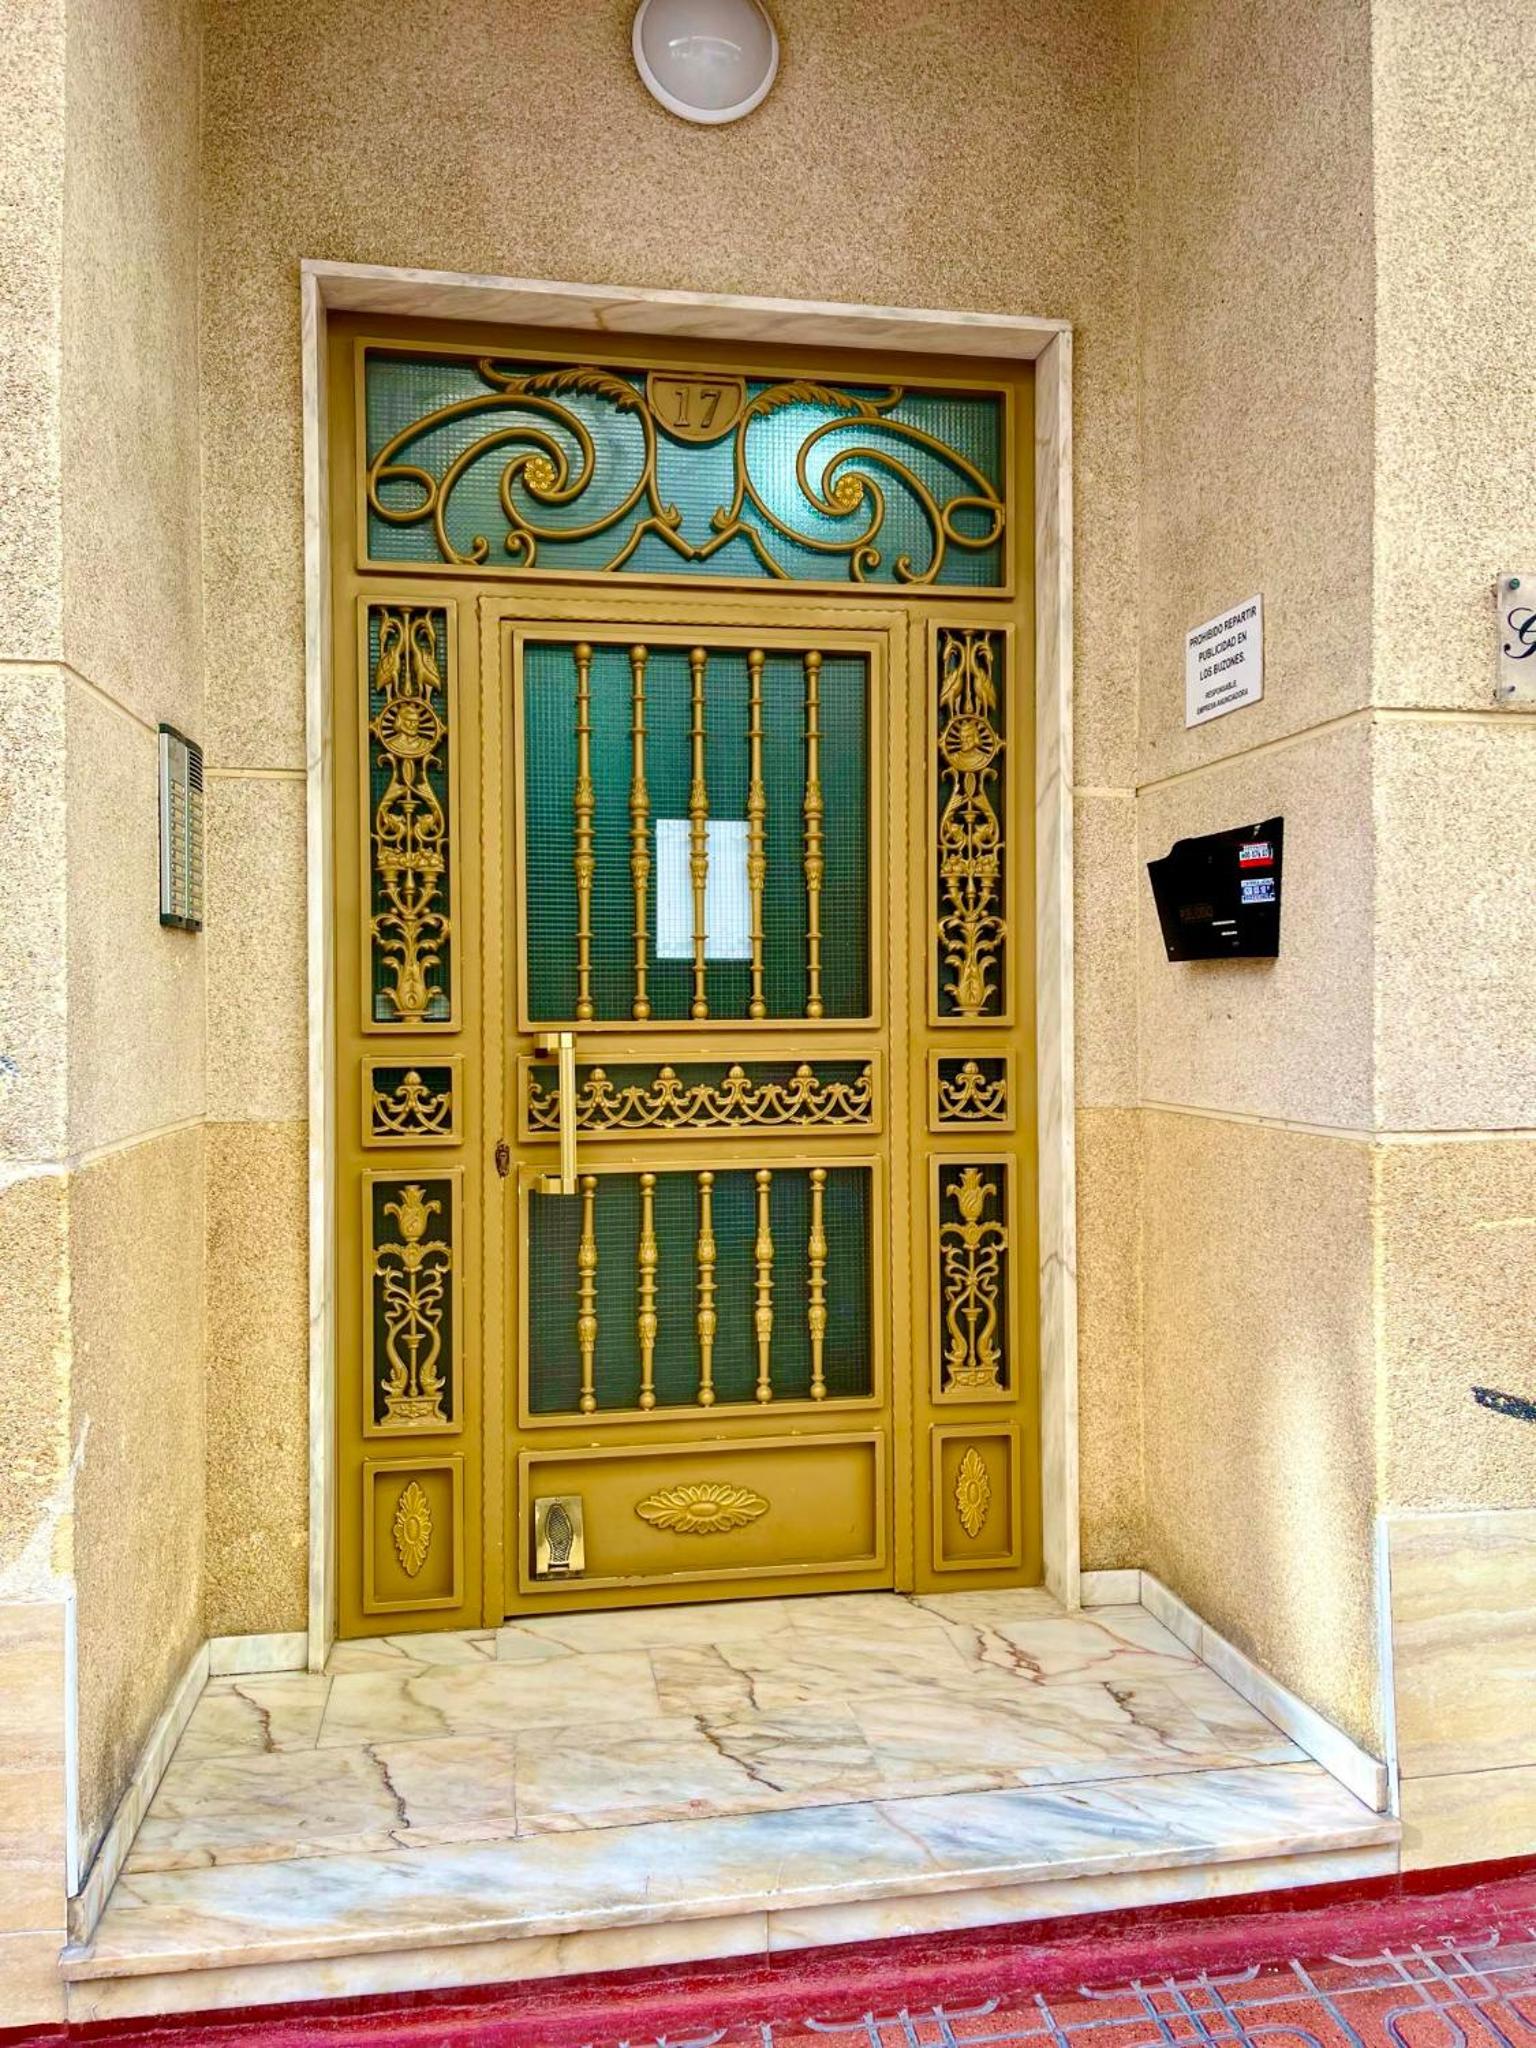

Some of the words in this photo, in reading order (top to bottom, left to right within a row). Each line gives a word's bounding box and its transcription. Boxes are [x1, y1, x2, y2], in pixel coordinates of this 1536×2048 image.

[673, 387, 721, 428] 17
[1190, 623, 1223, 647] PROHIBIDO
[1224, 605, 1257, 631] REPARTIR
[1198, 635, 1236, 662] PUBLICIDAD
[1237, 630, 1247, 644] EN
[1200, 667, 1212, 681] LOS
